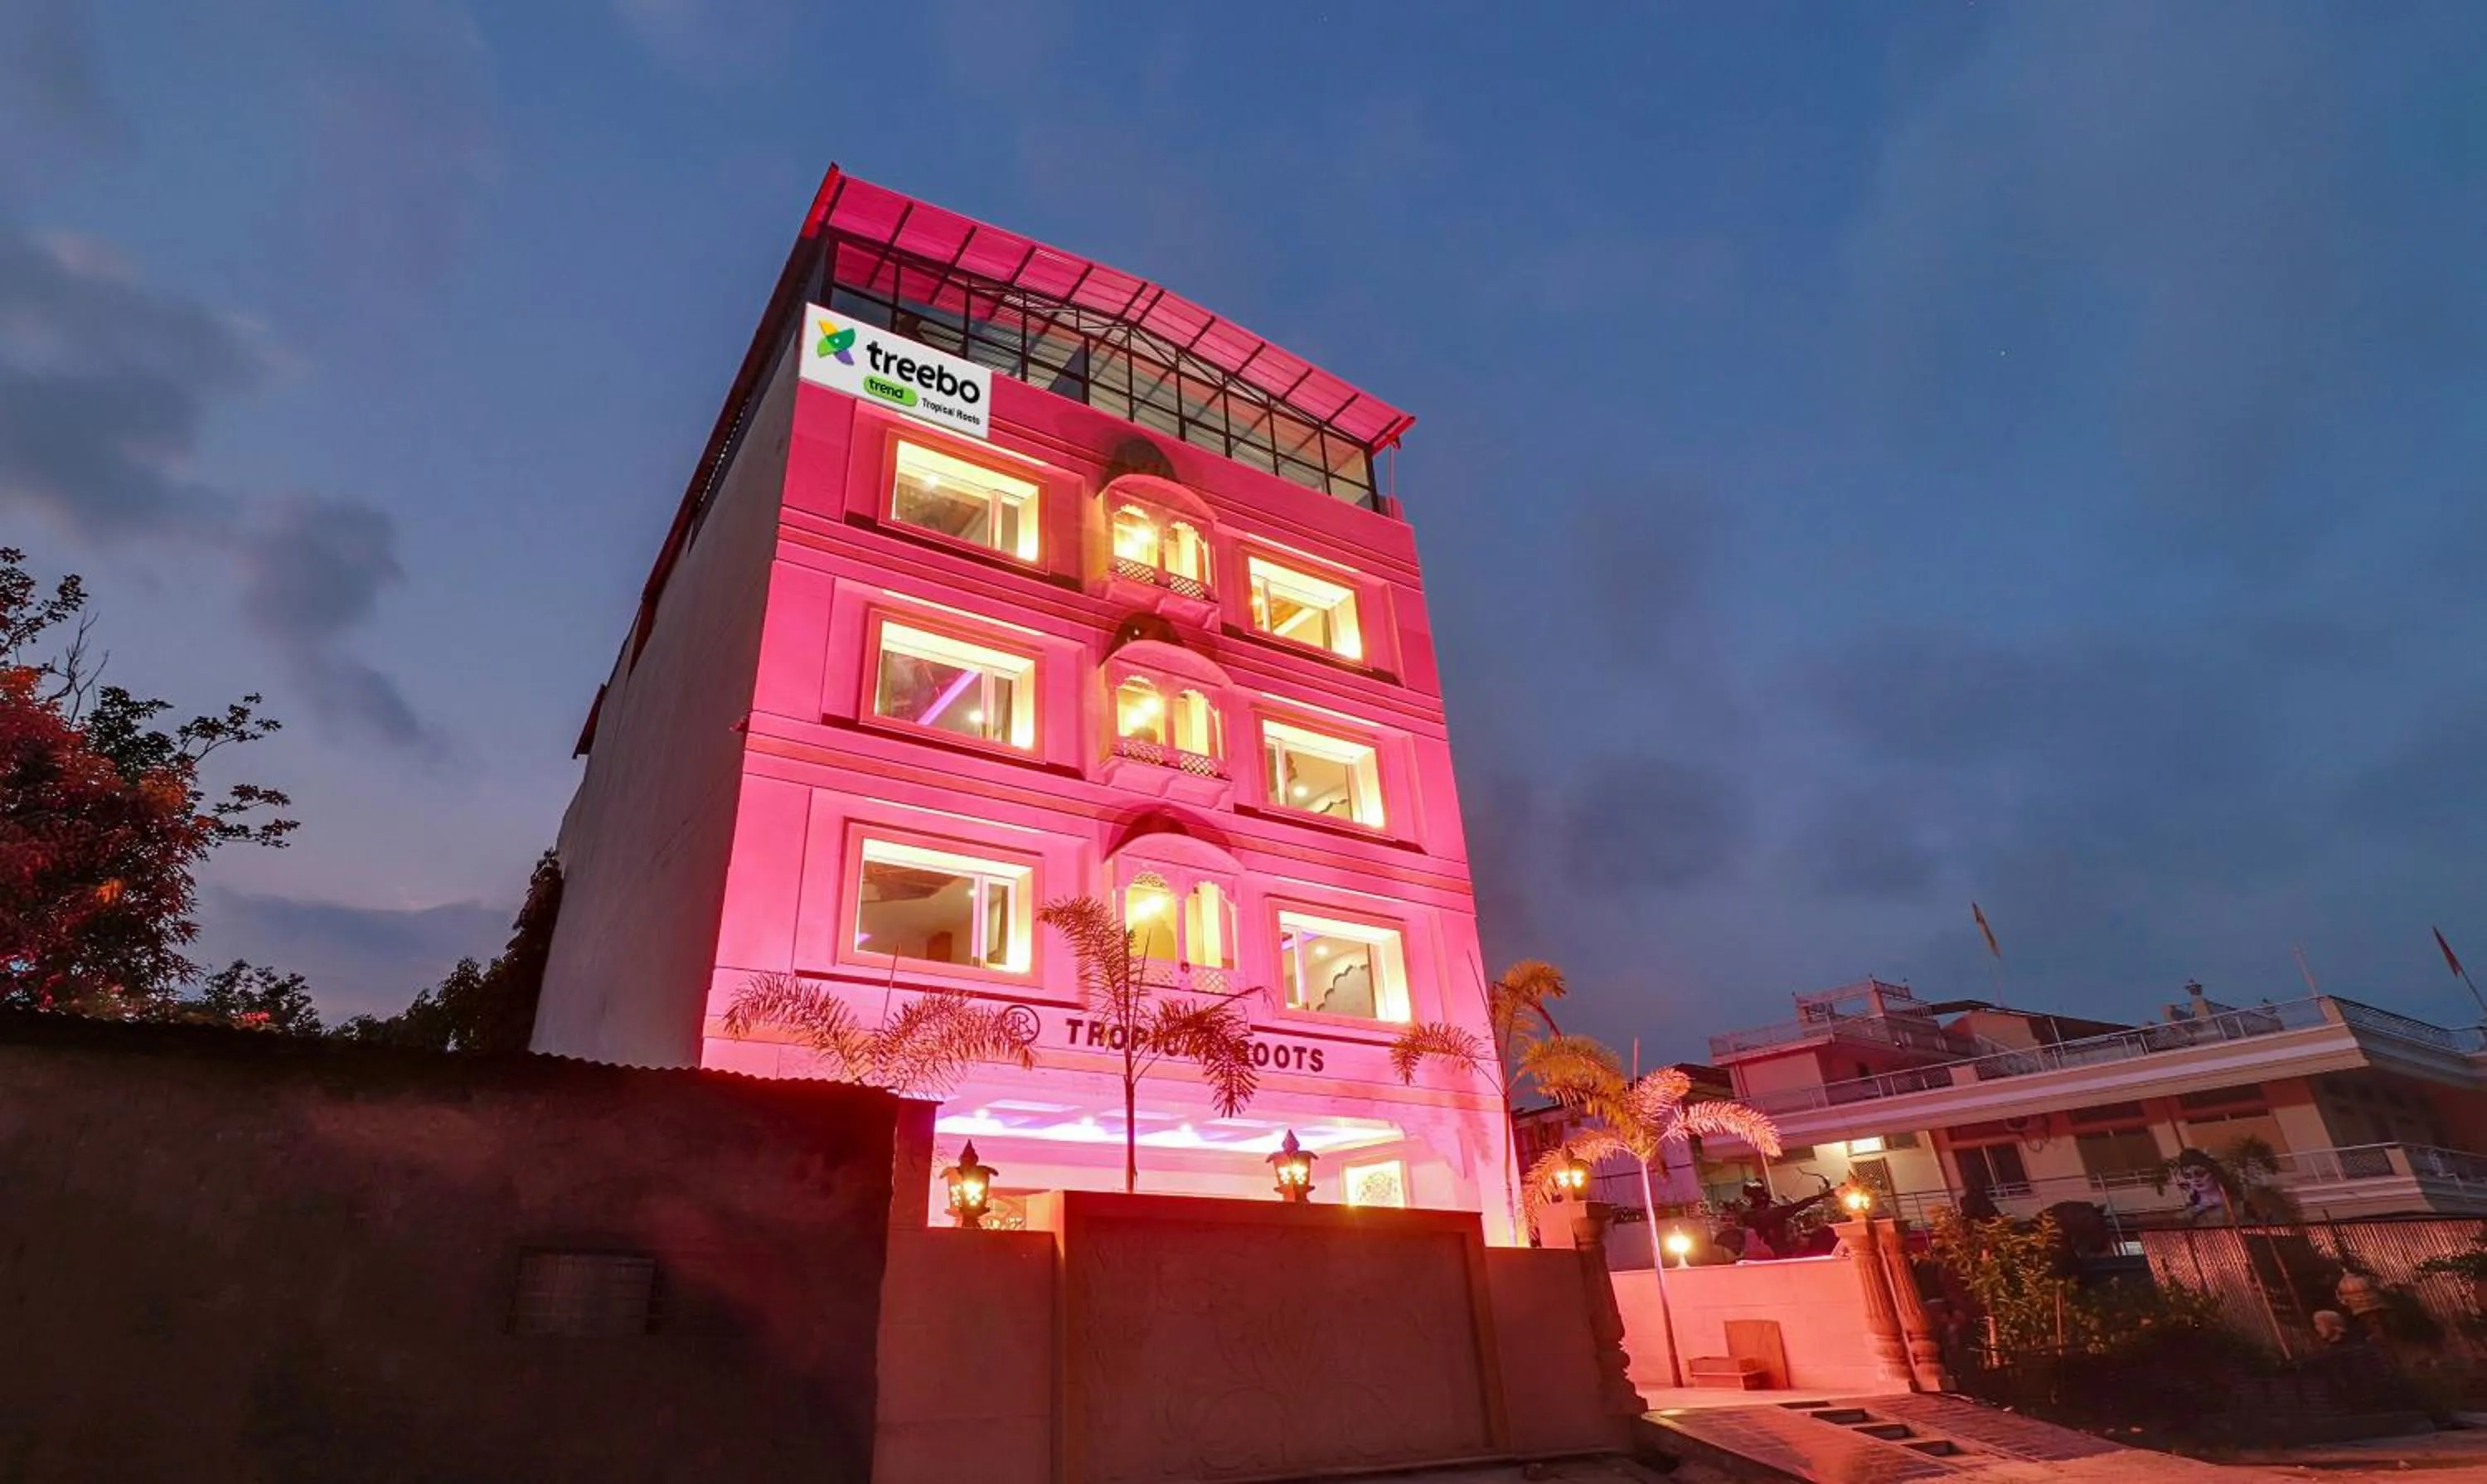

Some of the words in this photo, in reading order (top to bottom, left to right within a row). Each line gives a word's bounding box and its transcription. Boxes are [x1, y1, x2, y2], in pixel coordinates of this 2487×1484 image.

[866, 341, 981, 404] treebo
[869, 378, 904, 399] trend
[922, 398, 955, 416] Tropical
[957, 409, 981, 424] Roots
[1066, 1018, 1217, 1060] TROPIC
[1234, 1039, 1324, 1073] OOTS
